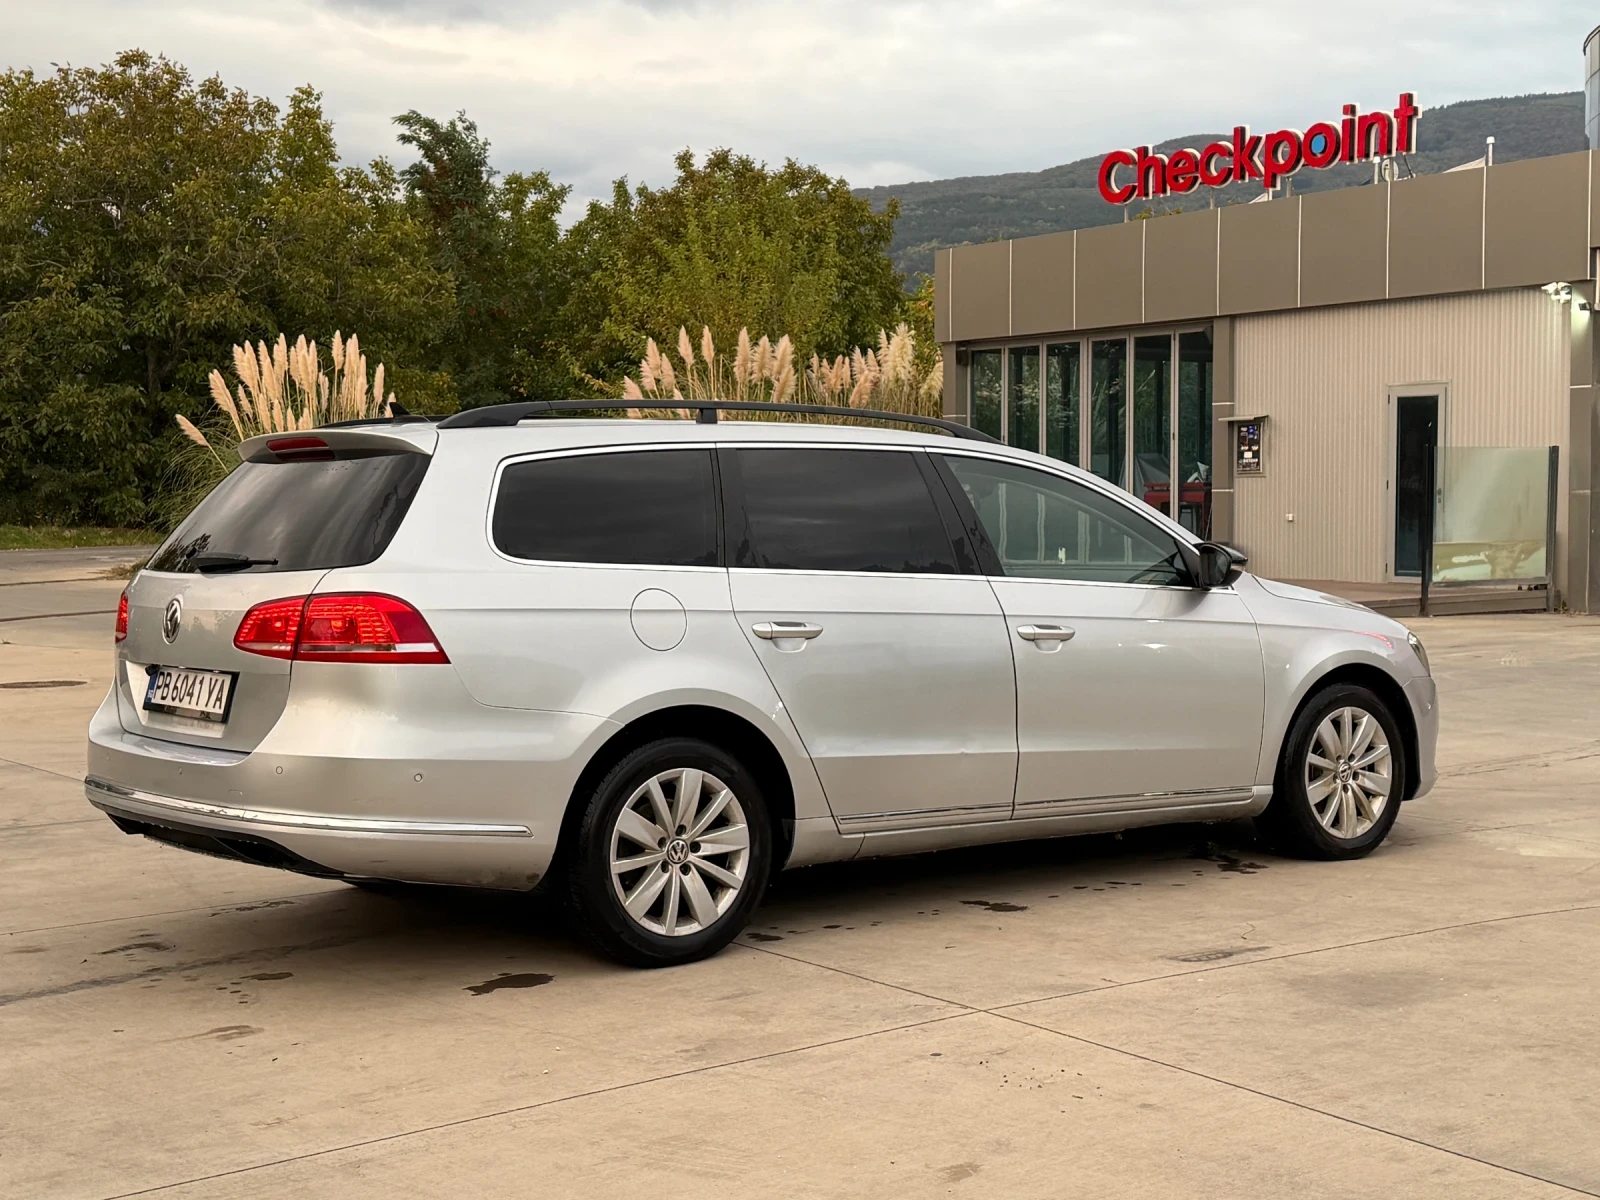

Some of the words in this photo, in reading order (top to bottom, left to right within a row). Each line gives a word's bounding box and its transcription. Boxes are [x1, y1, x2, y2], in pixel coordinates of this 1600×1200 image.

[1098, 92, 1420, 204] Checkpoint
[153, 671, 172, 700] PB
[172, 673, 205, 706] 6041
[205, 676, 225, 710] YA
[669, 840, 688, 862] VW
